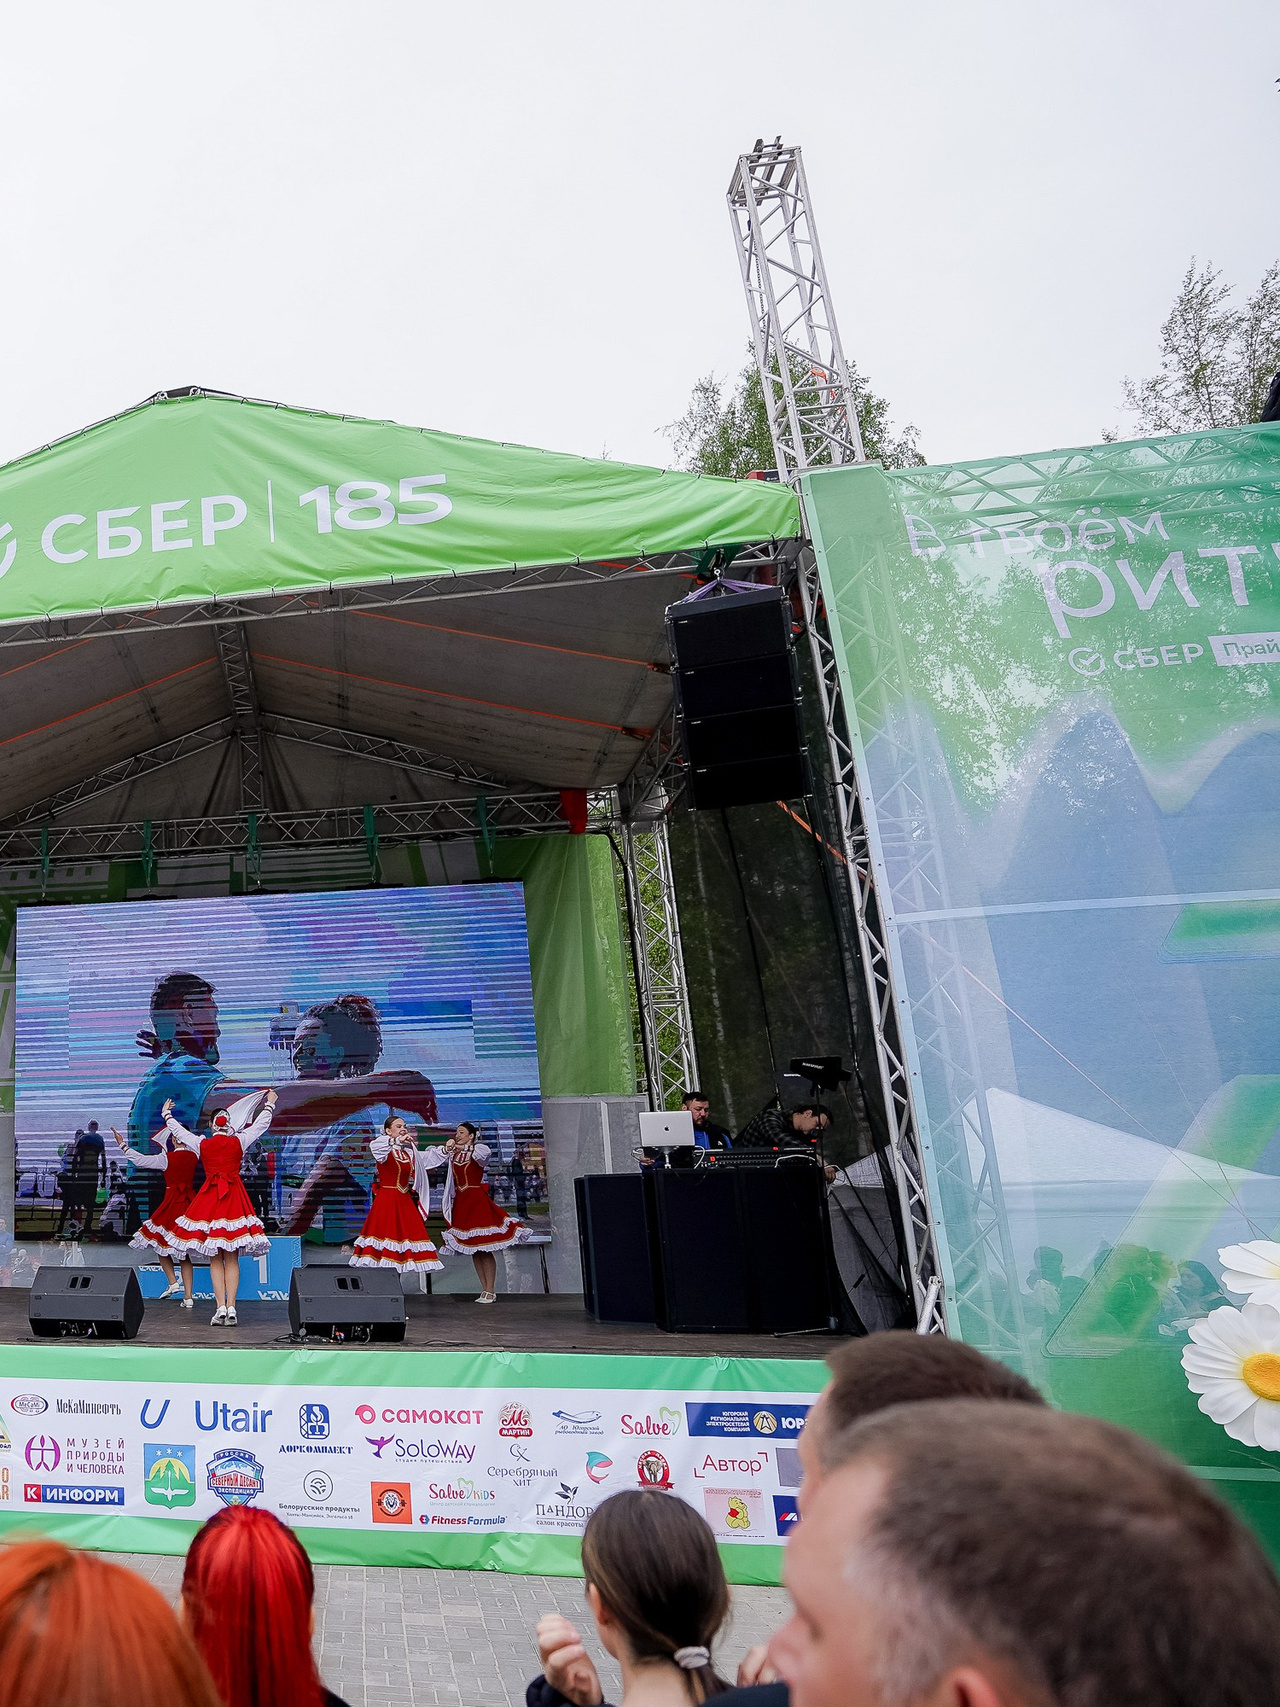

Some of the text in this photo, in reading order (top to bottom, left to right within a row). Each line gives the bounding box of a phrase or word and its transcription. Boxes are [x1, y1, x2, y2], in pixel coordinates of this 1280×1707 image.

[41, 474, 453, 564] СБЕР 185
[904, 507, 1170, 559] В твоём
[1036, 545, 1280, 638] рит
[1113, 638, 1280, 669] СБЕР Прай
[253, 1254, 268, 1285] 1
[56, 1398, 122, 1416] МеКаМинефть
[195, 1400, 273, 1433] Utair
[781, 1417, 807, 1430] ЮР
[621, 1414, 671, 1435] Salve
[501, 1428, 530, 1437] МАРТИН
[66, 1437, 125, 1449] МУЗЕЙ
[279, 1445, 354, 1455] ДОРКОМПЛЕКТ
[66, 1450, 125, 1463] ПРИРОДЫ
[66, 1463, 125, 1475] И ЧЕЛОВЕКА
[487, 1466, 558, 1479] Серебряный
[703, 1454, 762, 1476] Автор
[211, 1473, 259, 1487] СЕВЕРНЫЙ ДЕСАНТ
[513, 1479, 532, 1487] ХИТ
[27, 1487, 119, 1502] К ИНФОРМ
[429, 1483, 466, 1500] Salve
[279, 1503, 360, 1513] Белорусские продукты
[535, 1504, 594, 1519] ПАНДОР
[556, 1520, 584, 1528] красоты
